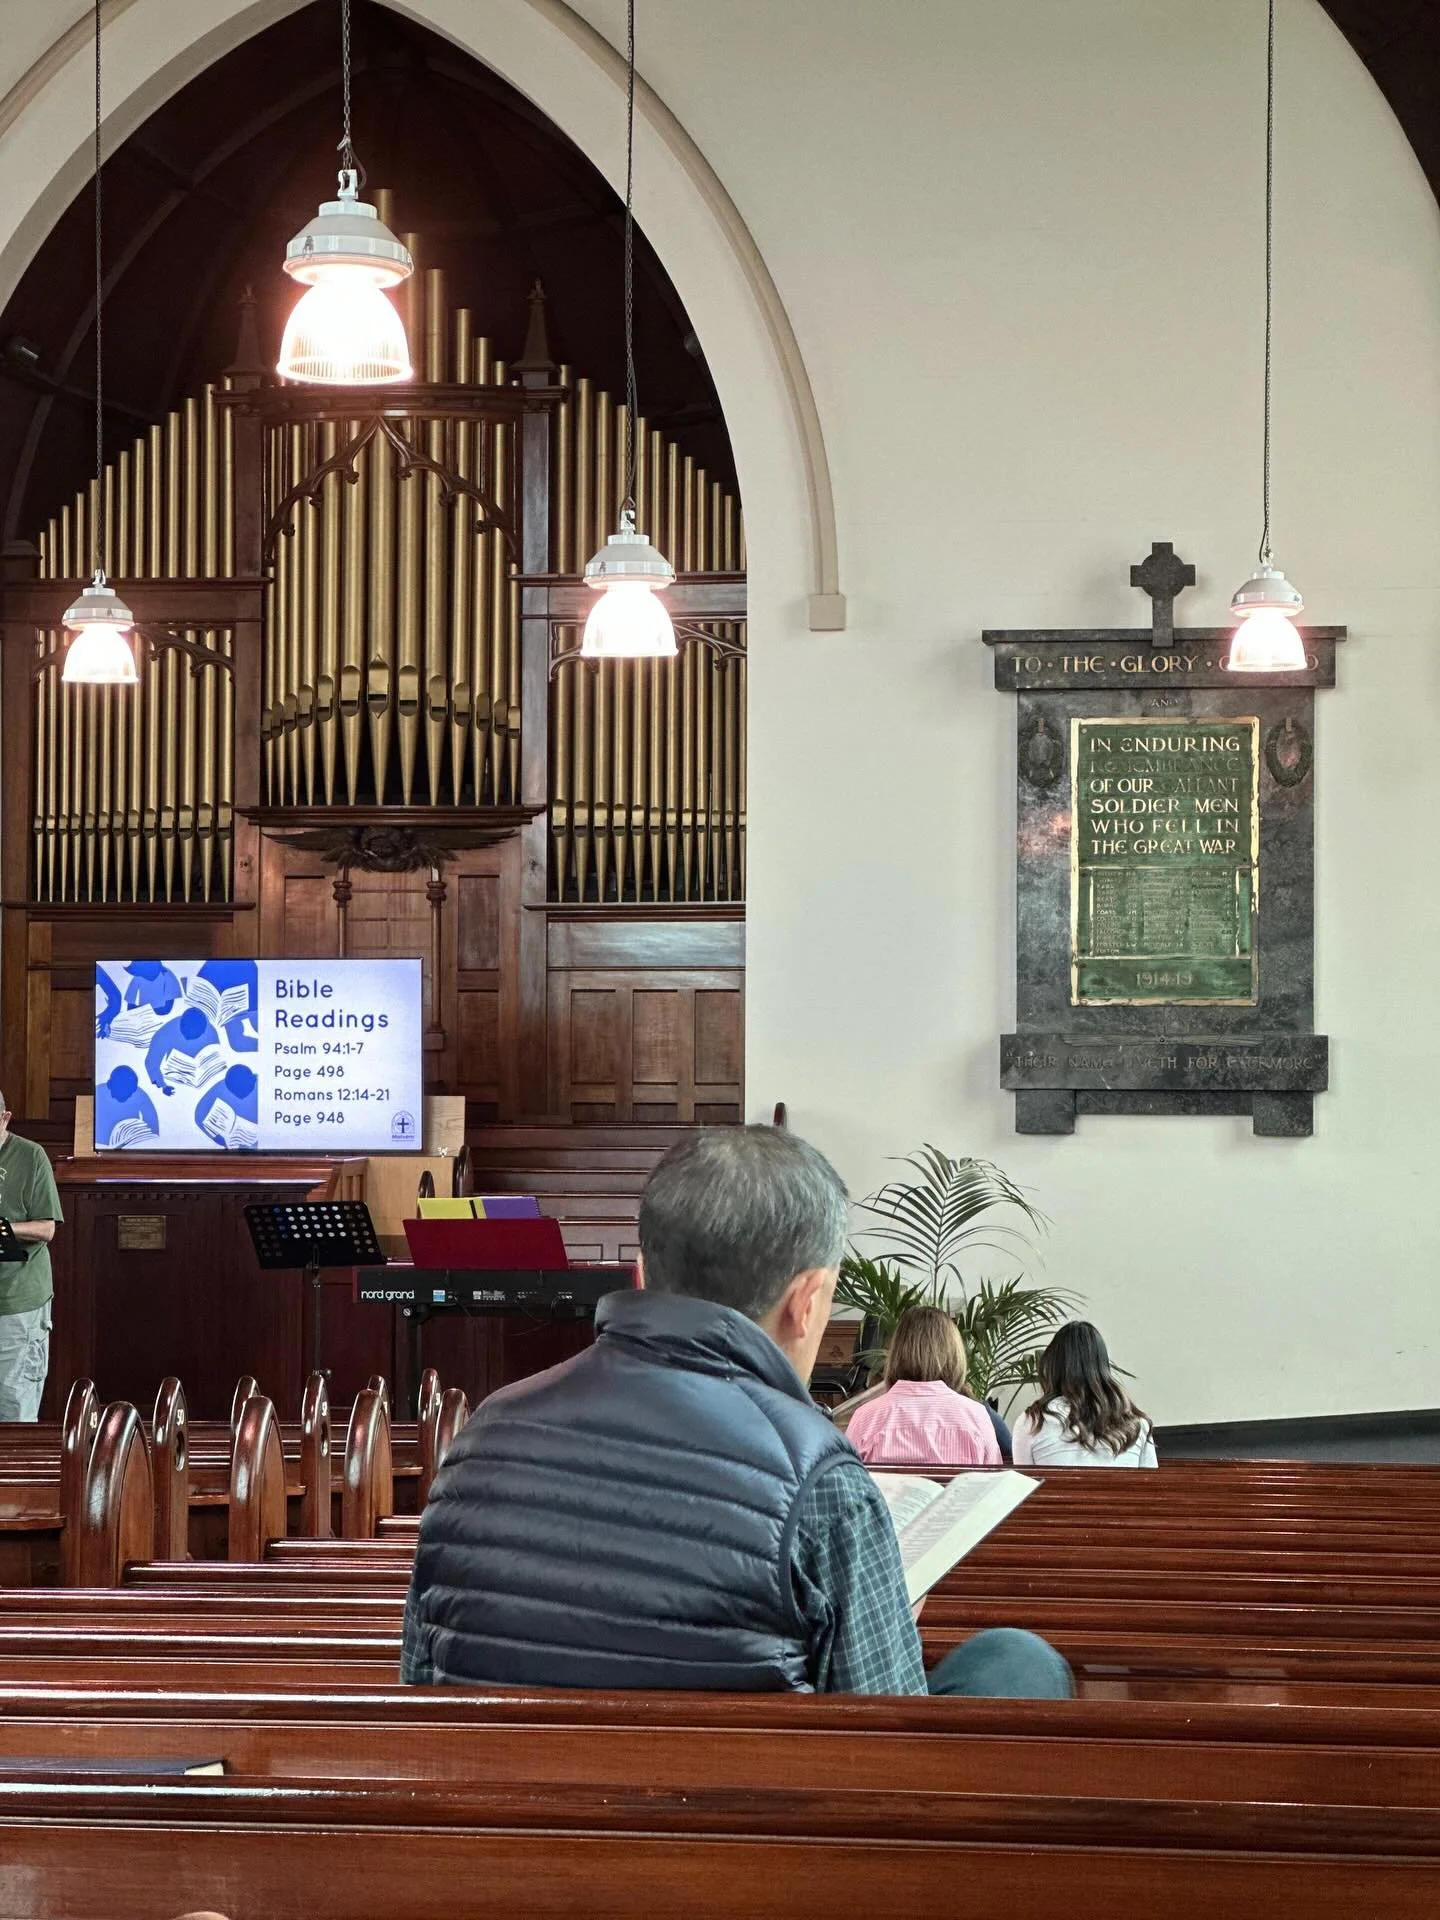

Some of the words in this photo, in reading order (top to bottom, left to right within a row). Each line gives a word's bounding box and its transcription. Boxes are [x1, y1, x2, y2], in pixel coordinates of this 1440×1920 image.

[1011, 656, 1042, 673] TO
[1060, 656, 1105, 673] THE
[1120, 655, 1199, 673] GLORY
[1090, 737, 1112, 753] IN
[1120, 736, 1240, 753] ENDURING
[1090, 778, 1113, 793] OF
[1117, 778, 1157, 793] OUR
[1090, 799, 1182, 814] SOLDIER
[1194, 798, 1239, 814] MEN
[1090, 819, 1144, 834] WHO
[1152, 819, 1207, 834] FELL
[1216, 818, 1239, 834] IN
[1091, 840, 1127, 855] THE
[1133, 839, 1194, 855] GREAT
[1199, 839, 1237, 854] WAR
[276, 979, 333, 998] Bible
[275, 1009, 389, 1032] Readings
[274, 1042, 317, 1055] Psalm
[322, 1042, 364, 1055] 94:1-7
[1188, 1056, 1218, 1069] FOR
[274, 1065, 312, 1080] Page
[316, 1065, 345, 1078] 498
[274, 1088, 333, 1101] Romans
[337, 1088, 390, 1101] 12:14-21
[274, 1111, 312, 1126] Page
[316, 1111, 345, 1124] 948
[361, 1289, 384, 1299] nord
[385, 1289, 415, 1301] grand
